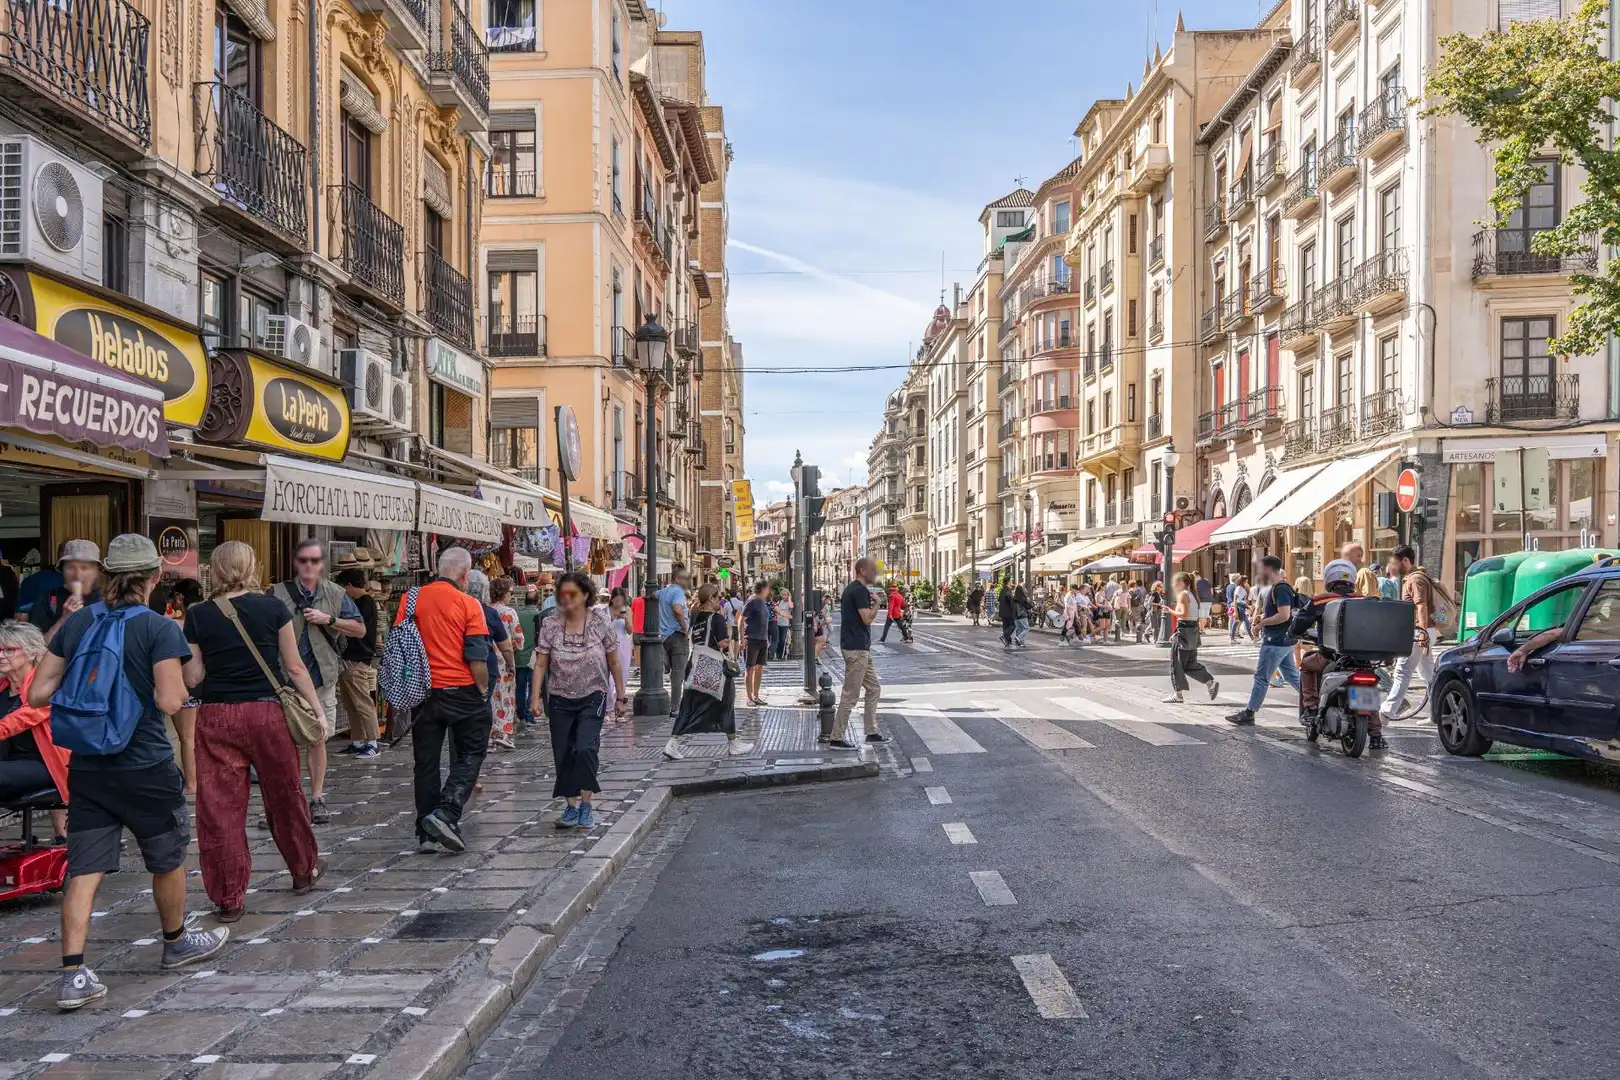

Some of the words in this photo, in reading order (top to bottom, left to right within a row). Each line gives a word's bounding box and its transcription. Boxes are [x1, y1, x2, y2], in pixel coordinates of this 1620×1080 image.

[87, 311, 169, 383] Helados
[19, 373, 161, 443] RECUERDOS
[279, 382, 297, 424] La
[297, 388, 329, 433] Perla
[1449, 451, 1495, 461] ARTESANOS
[272, 479, 350, 518] HORCHATA
[353, 490, 371, 520] DE
[373, 493, 414, 523] CHUFAS
[423, 500, 462, 532] HELADOS
[464, 509, 501, 537] ARTESANOS
[514, 499, 536, 521] SUR
